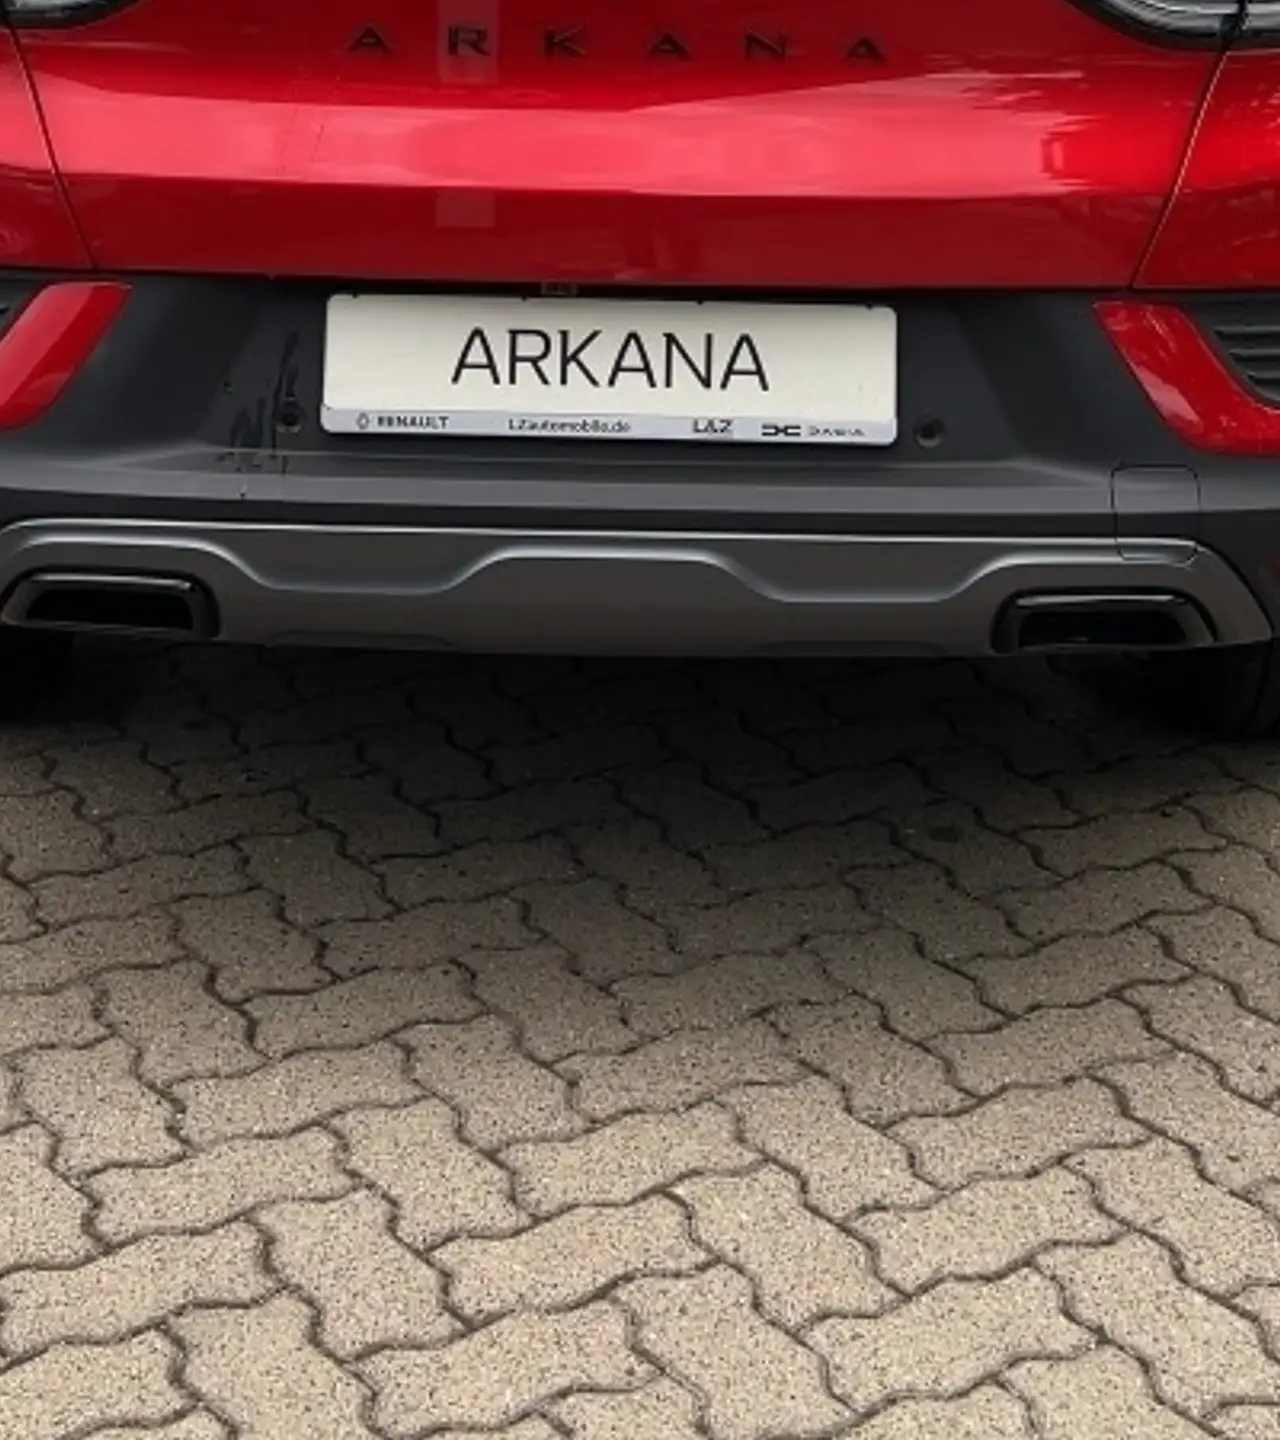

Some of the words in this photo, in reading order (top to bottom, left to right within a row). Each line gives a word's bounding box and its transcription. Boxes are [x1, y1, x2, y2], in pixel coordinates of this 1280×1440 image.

[347, 24, 889, 62] ARKANA
[451, 326, 770, 392] ARKANA
[376, 415, 450, 430] RENAULT
